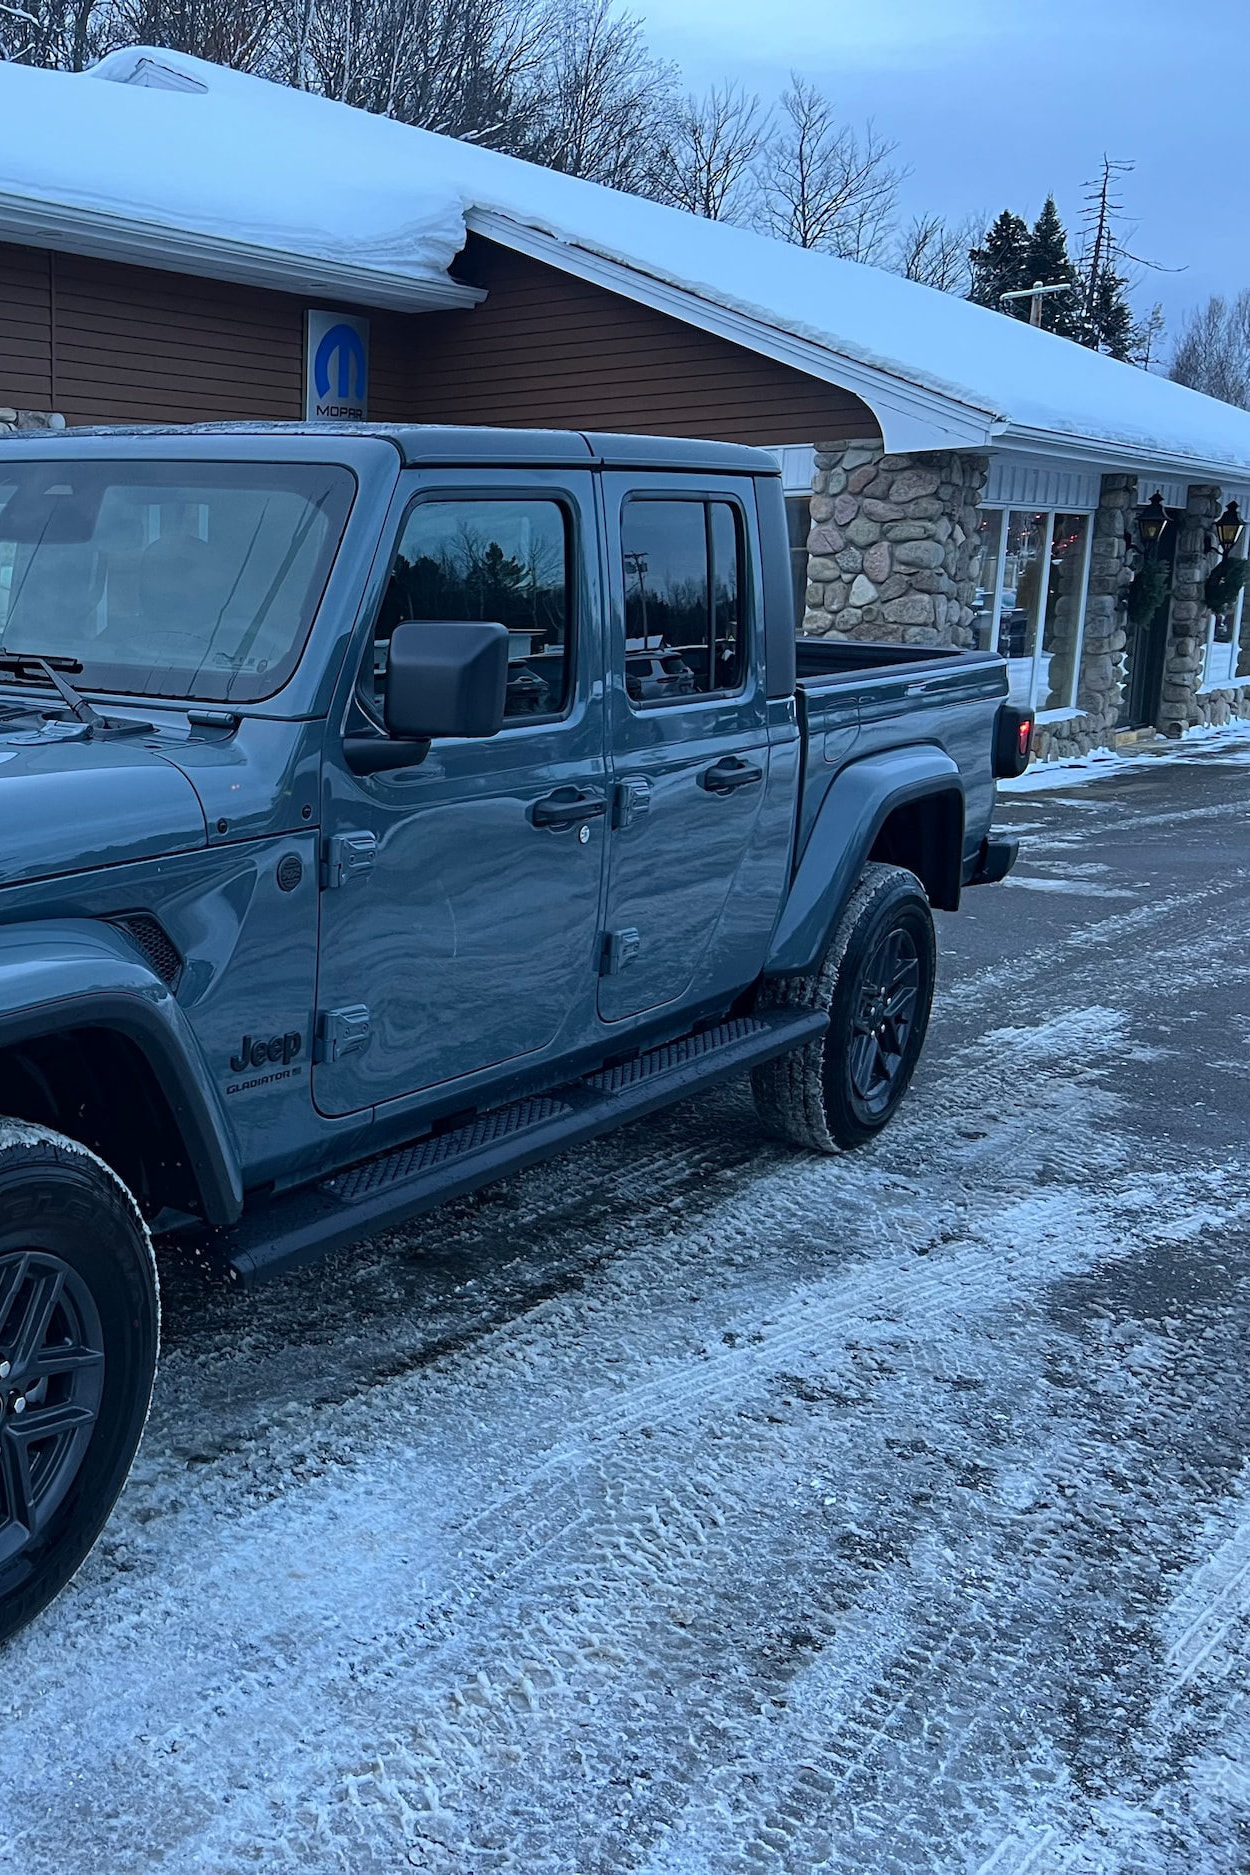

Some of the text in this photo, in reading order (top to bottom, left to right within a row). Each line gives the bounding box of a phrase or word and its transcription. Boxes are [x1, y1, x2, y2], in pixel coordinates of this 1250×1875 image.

[316, 405, 363, 419] MOPAR
[230, 1030, 302, 1072] Jeep
[226, 1069, 291, 1095] GLADIATOR
